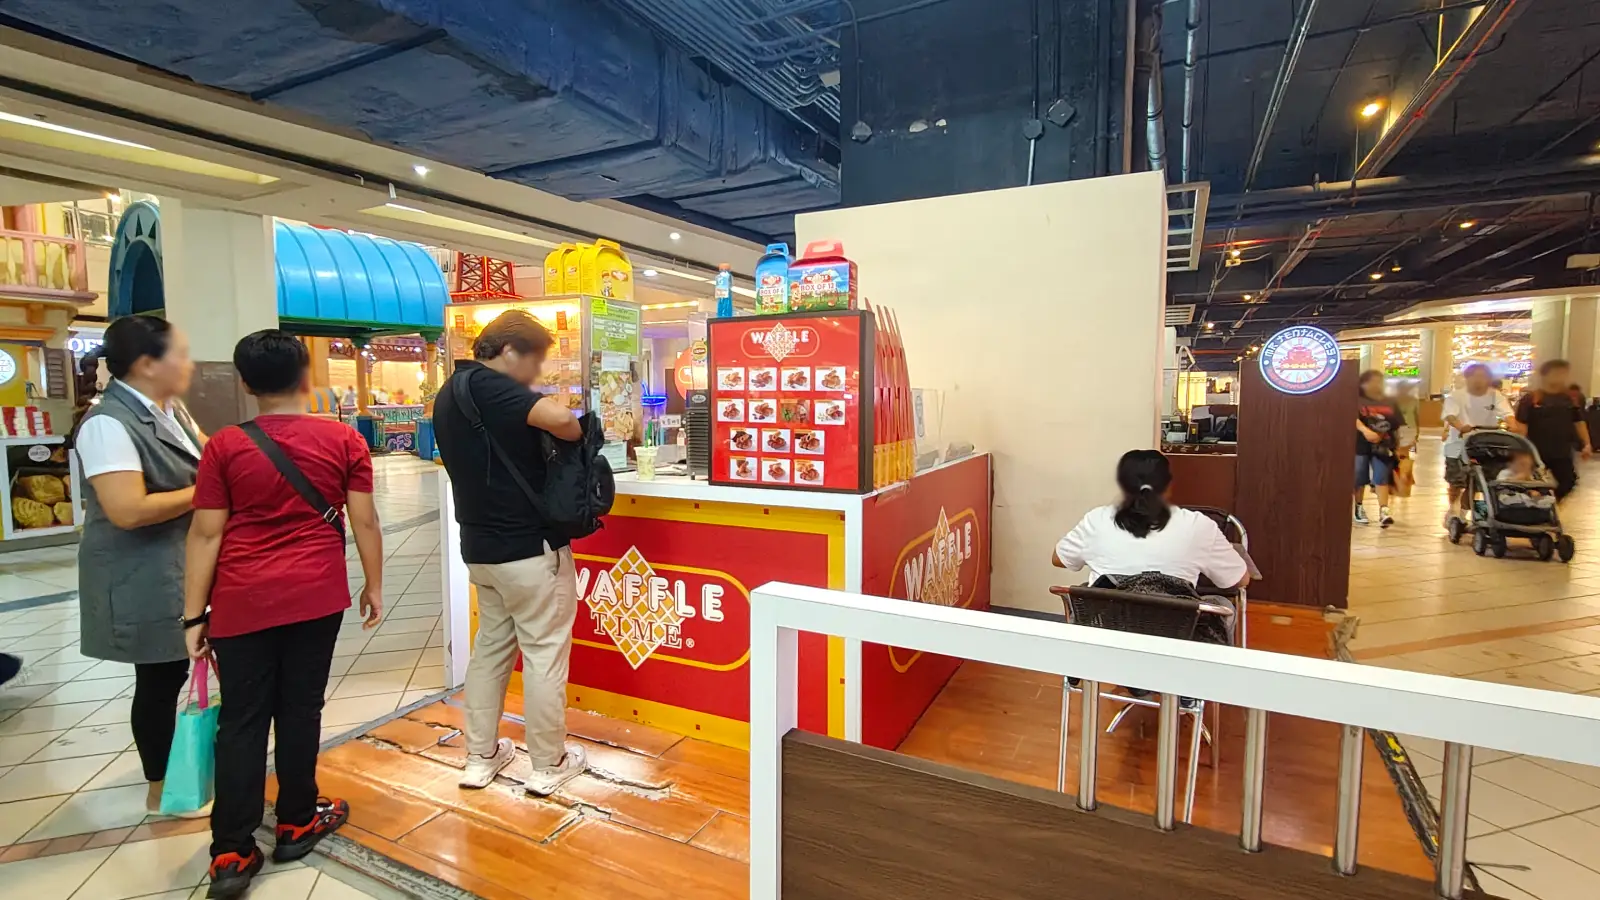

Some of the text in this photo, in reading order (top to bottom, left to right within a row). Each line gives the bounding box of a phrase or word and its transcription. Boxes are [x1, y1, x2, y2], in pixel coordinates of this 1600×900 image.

[751, 330, 809, 344] WAFFLE
[1264, 329, 1337, 357] MR TENTACLES
[904, 521, 972, 602] WAFFLE
[590, 611, 682, 649] TIME
